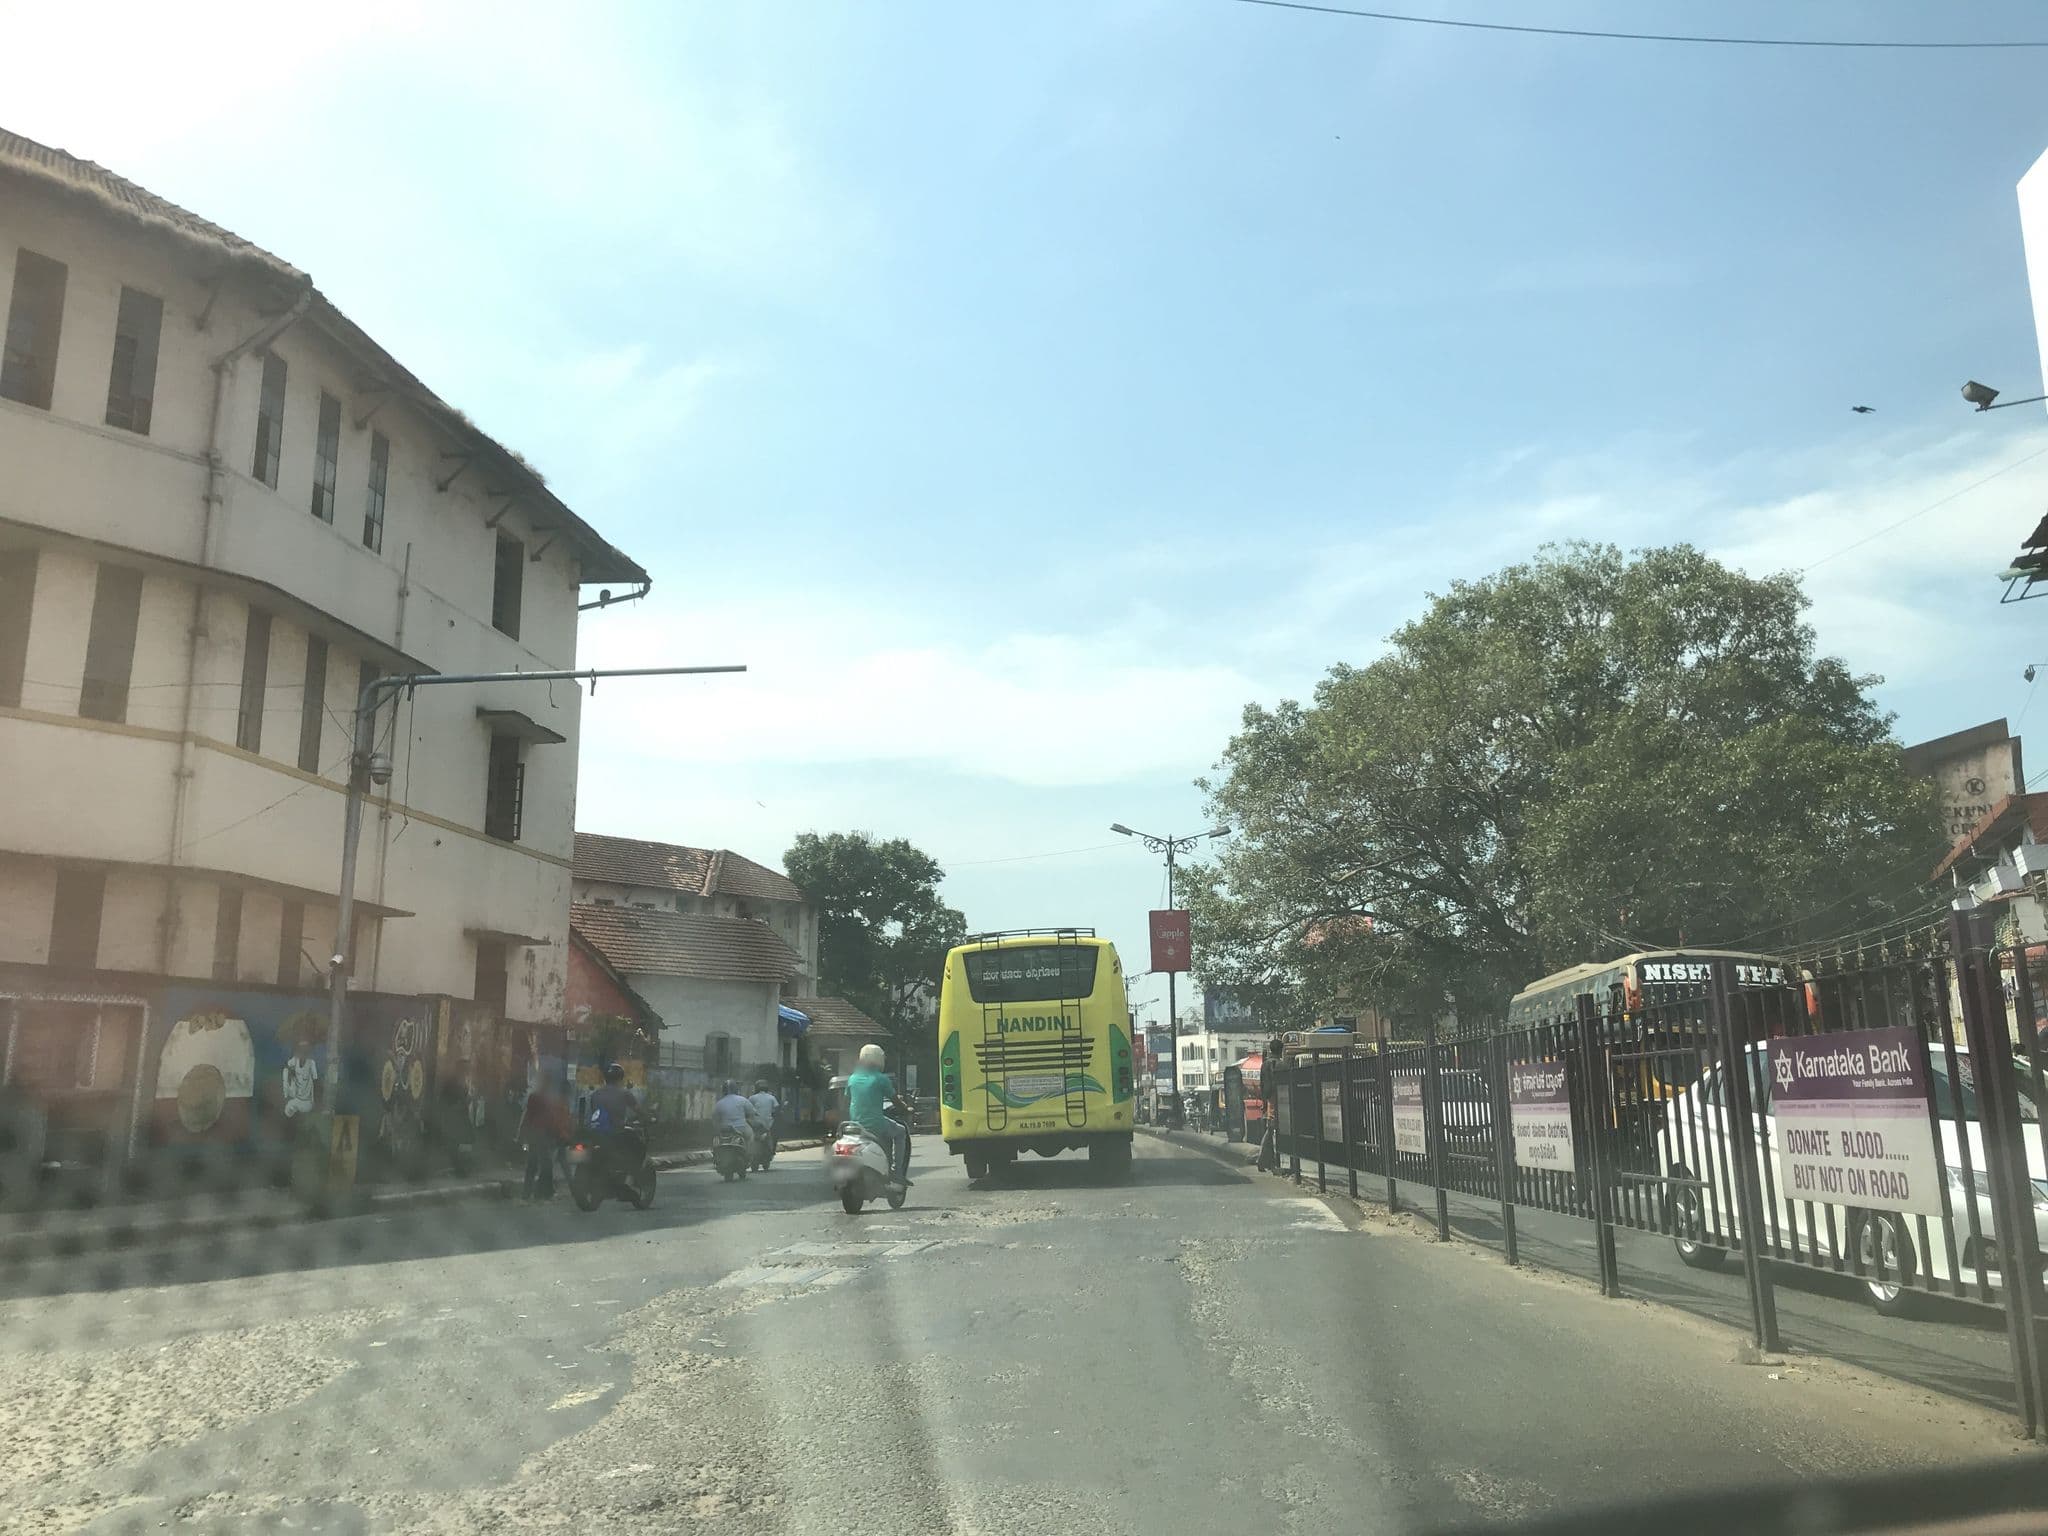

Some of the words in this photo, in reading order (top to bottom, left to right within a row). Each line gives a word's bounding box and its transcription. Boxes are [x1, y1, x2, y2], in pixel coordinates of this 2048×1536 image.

[997, 1015, 1072, 1033] NANDINI
[1795, 1048, 1866, 1078] Karnataka
[1868, 1042, 1912, 1074] Bank
[1786, 1129, 1832, 1156] DONATE
[1793, 1164, 1816, 1191] BUT
[1819, 1166, 1844, 1194] NOT
[1847, 1167, 1868, 1196] ON
[1869, 1169, 1909, 1200] ROAD
